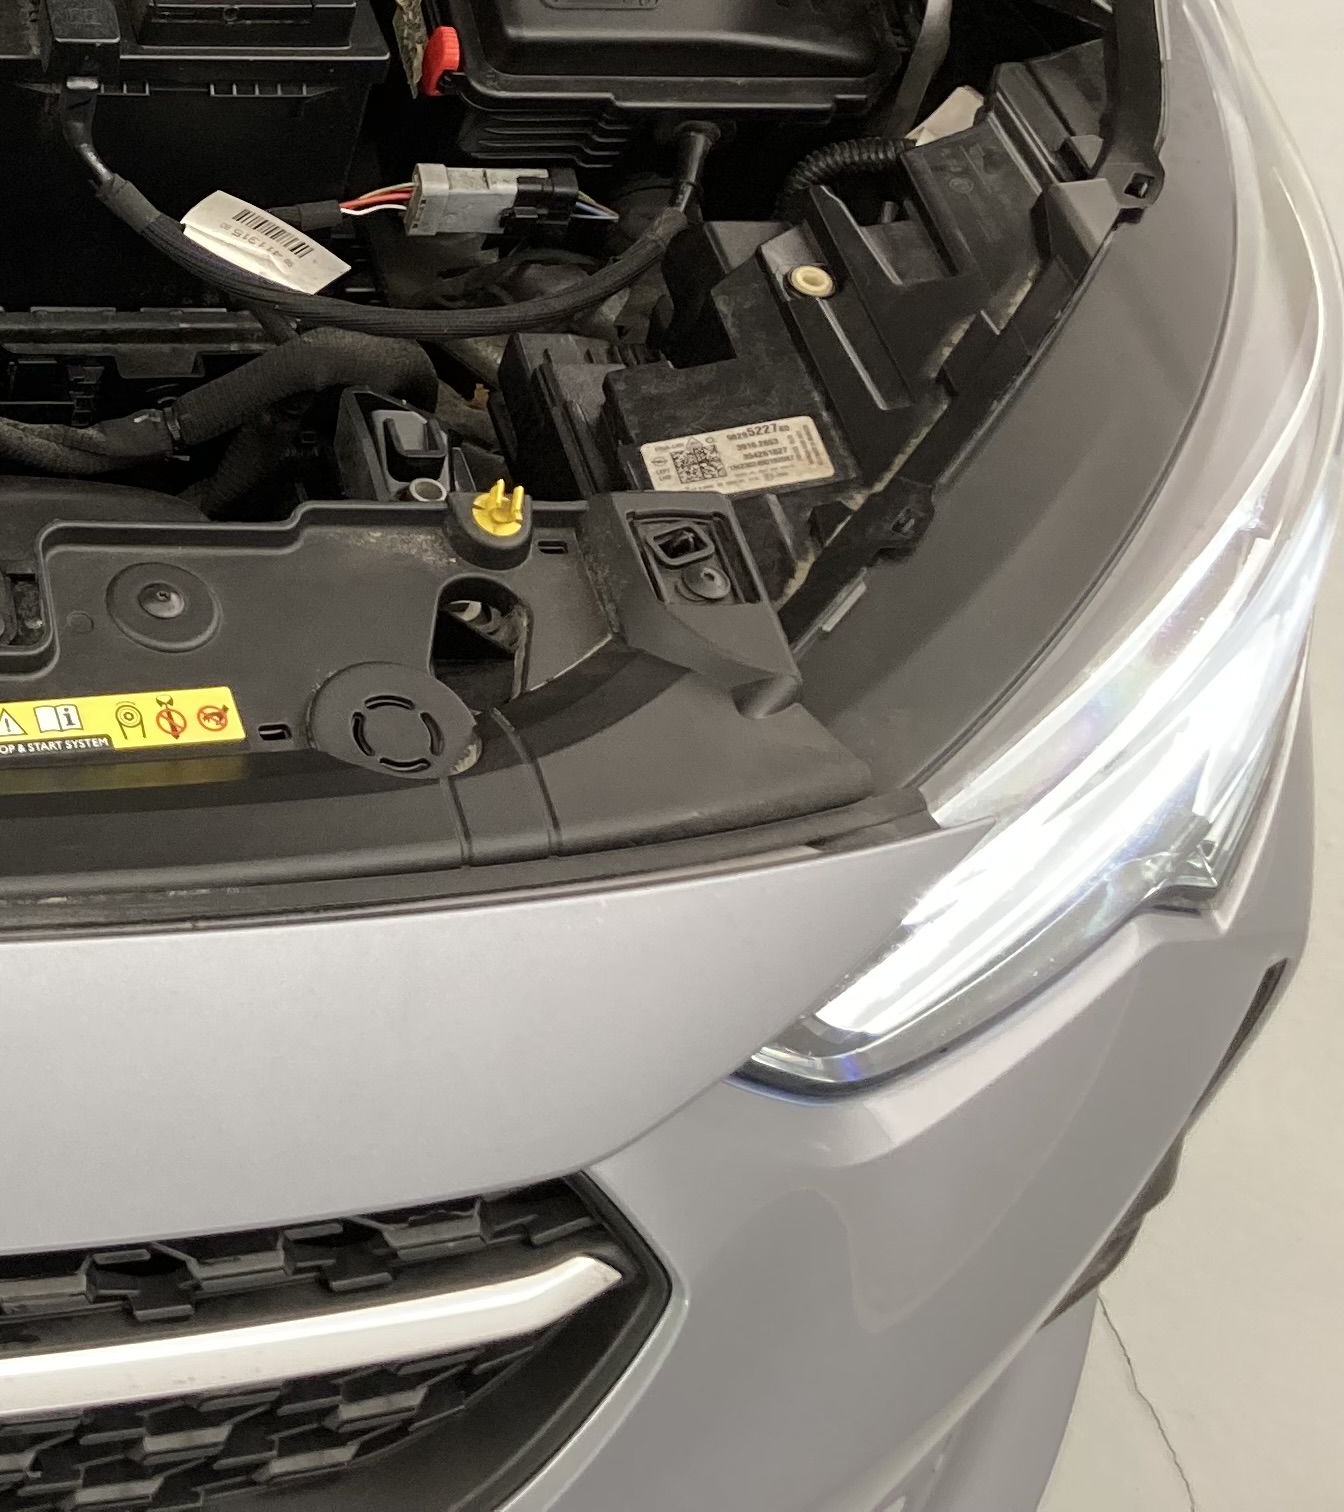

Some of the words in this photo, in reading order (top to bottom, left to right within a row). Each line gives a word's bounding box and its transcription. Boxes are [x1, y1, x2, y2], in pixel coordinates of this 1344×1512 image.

[17, 743, 26, 754] &
[26, 740, 63, 753] START
[65, 737, 110, 751] SYSTEM
